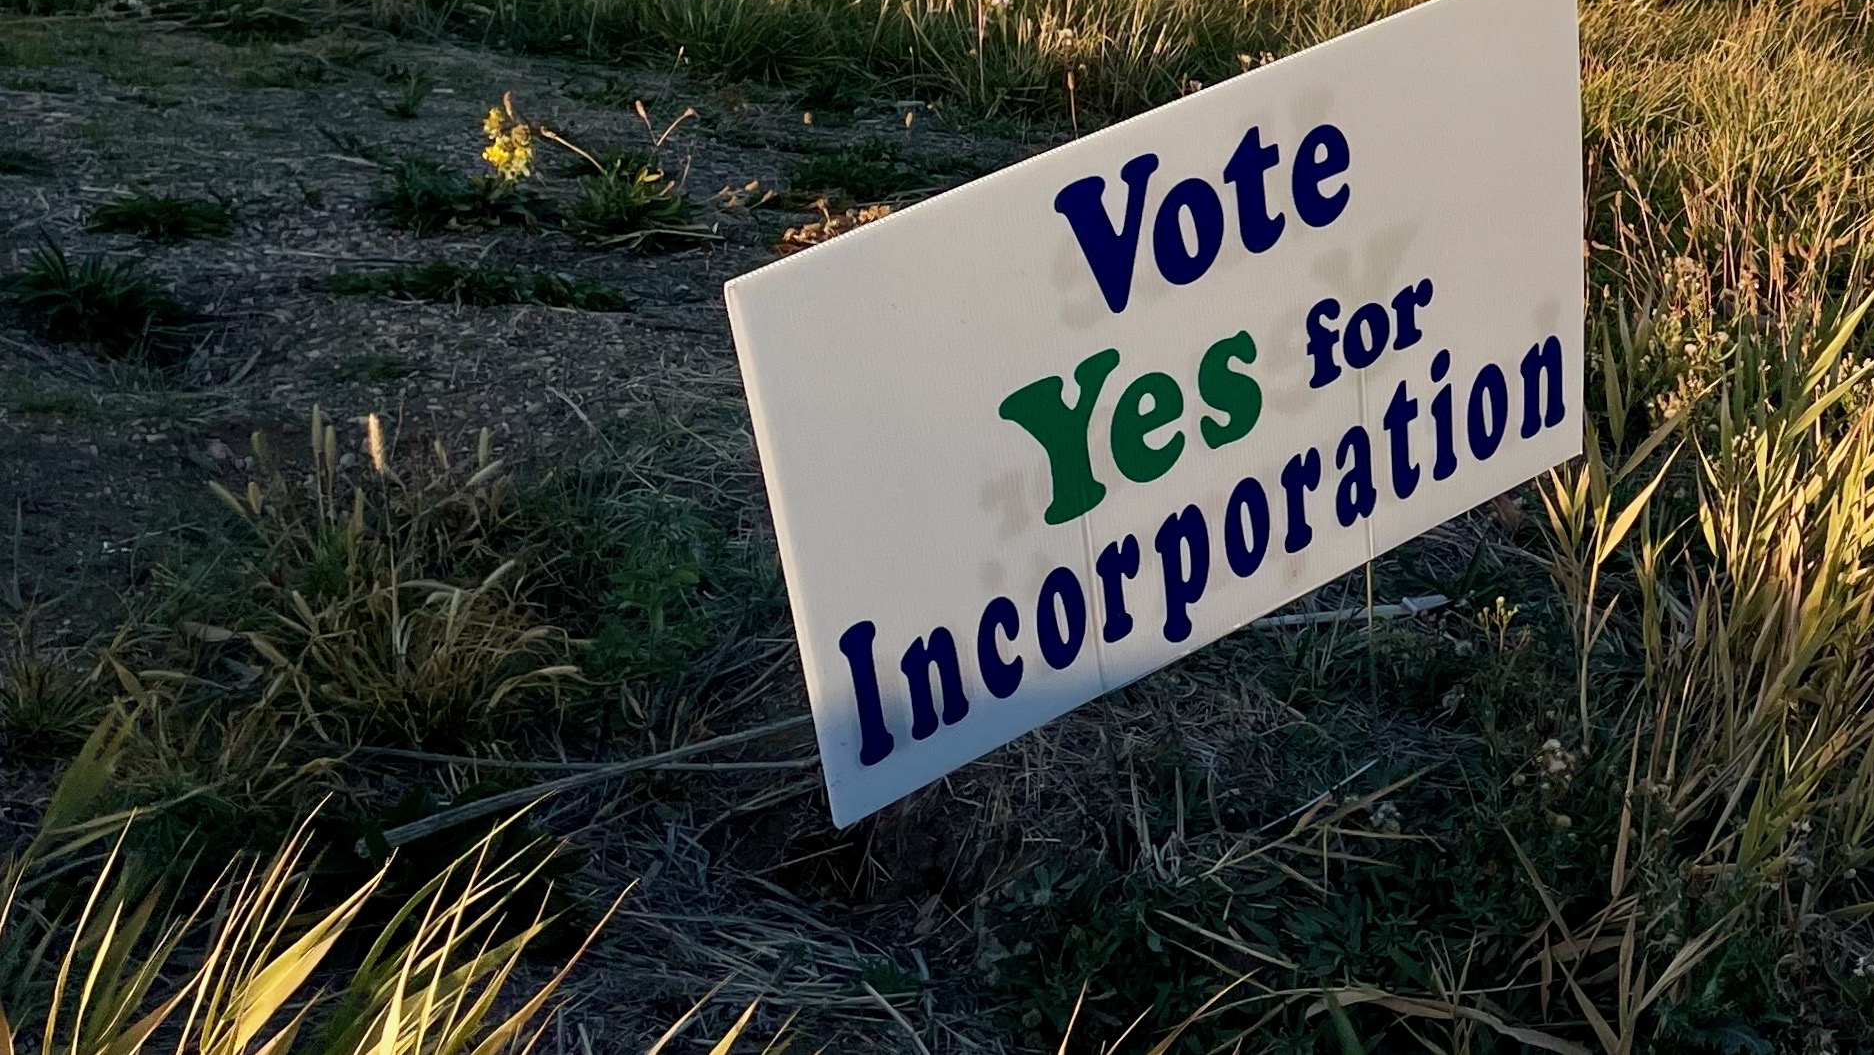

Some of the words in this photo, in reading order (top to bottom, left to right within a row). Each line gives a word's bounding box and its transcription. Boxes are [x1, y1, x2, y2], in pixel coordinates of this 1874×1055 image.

[1055, 124, 1351, 314] Vote
[999, 330, 1263, 526] Yes
[1306, 279, 1434, 389] for
[839, 335, 1566, 767] Incorporation
